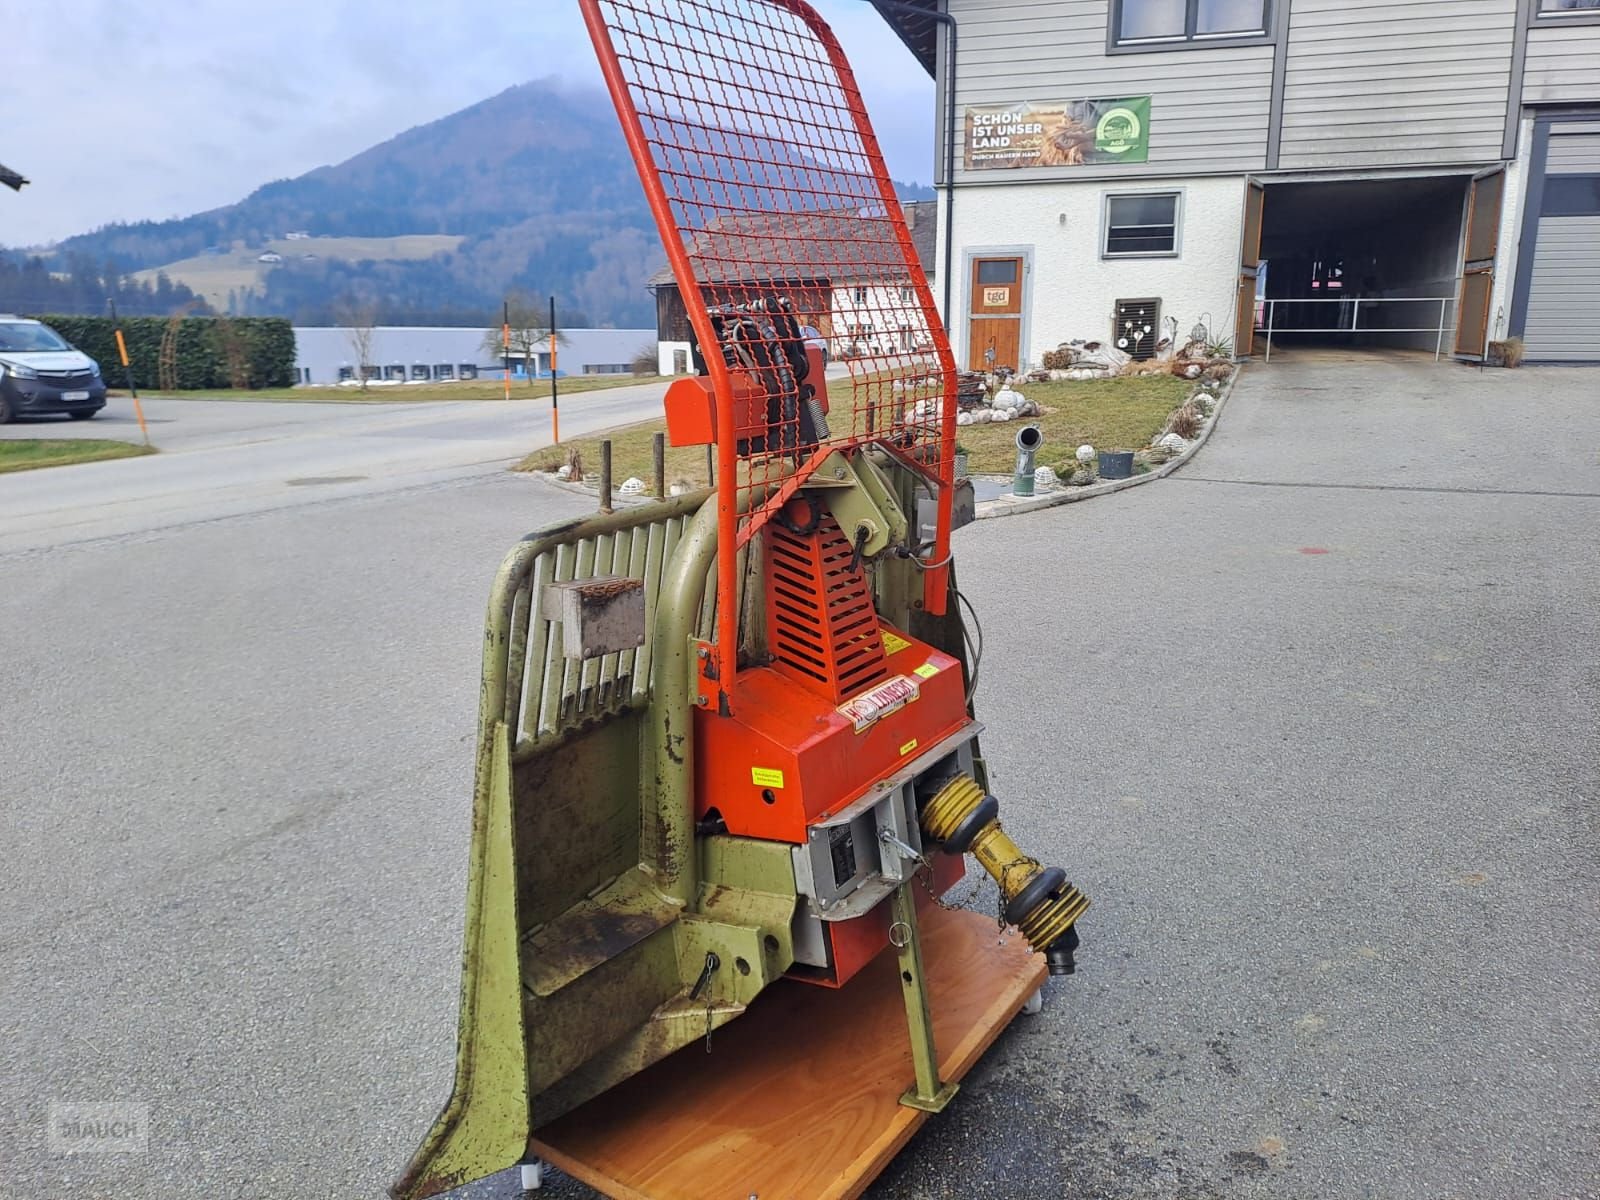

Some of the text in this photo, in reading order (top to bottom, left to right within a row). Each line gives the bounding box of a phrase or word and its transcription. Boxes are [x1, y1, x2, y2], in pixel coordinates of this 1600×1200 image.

[973, 112, 1022, 126] SCHÖN
[972, 123, 1042, 137] IST UNSER
[972, 136, 1011, 149] LAND
